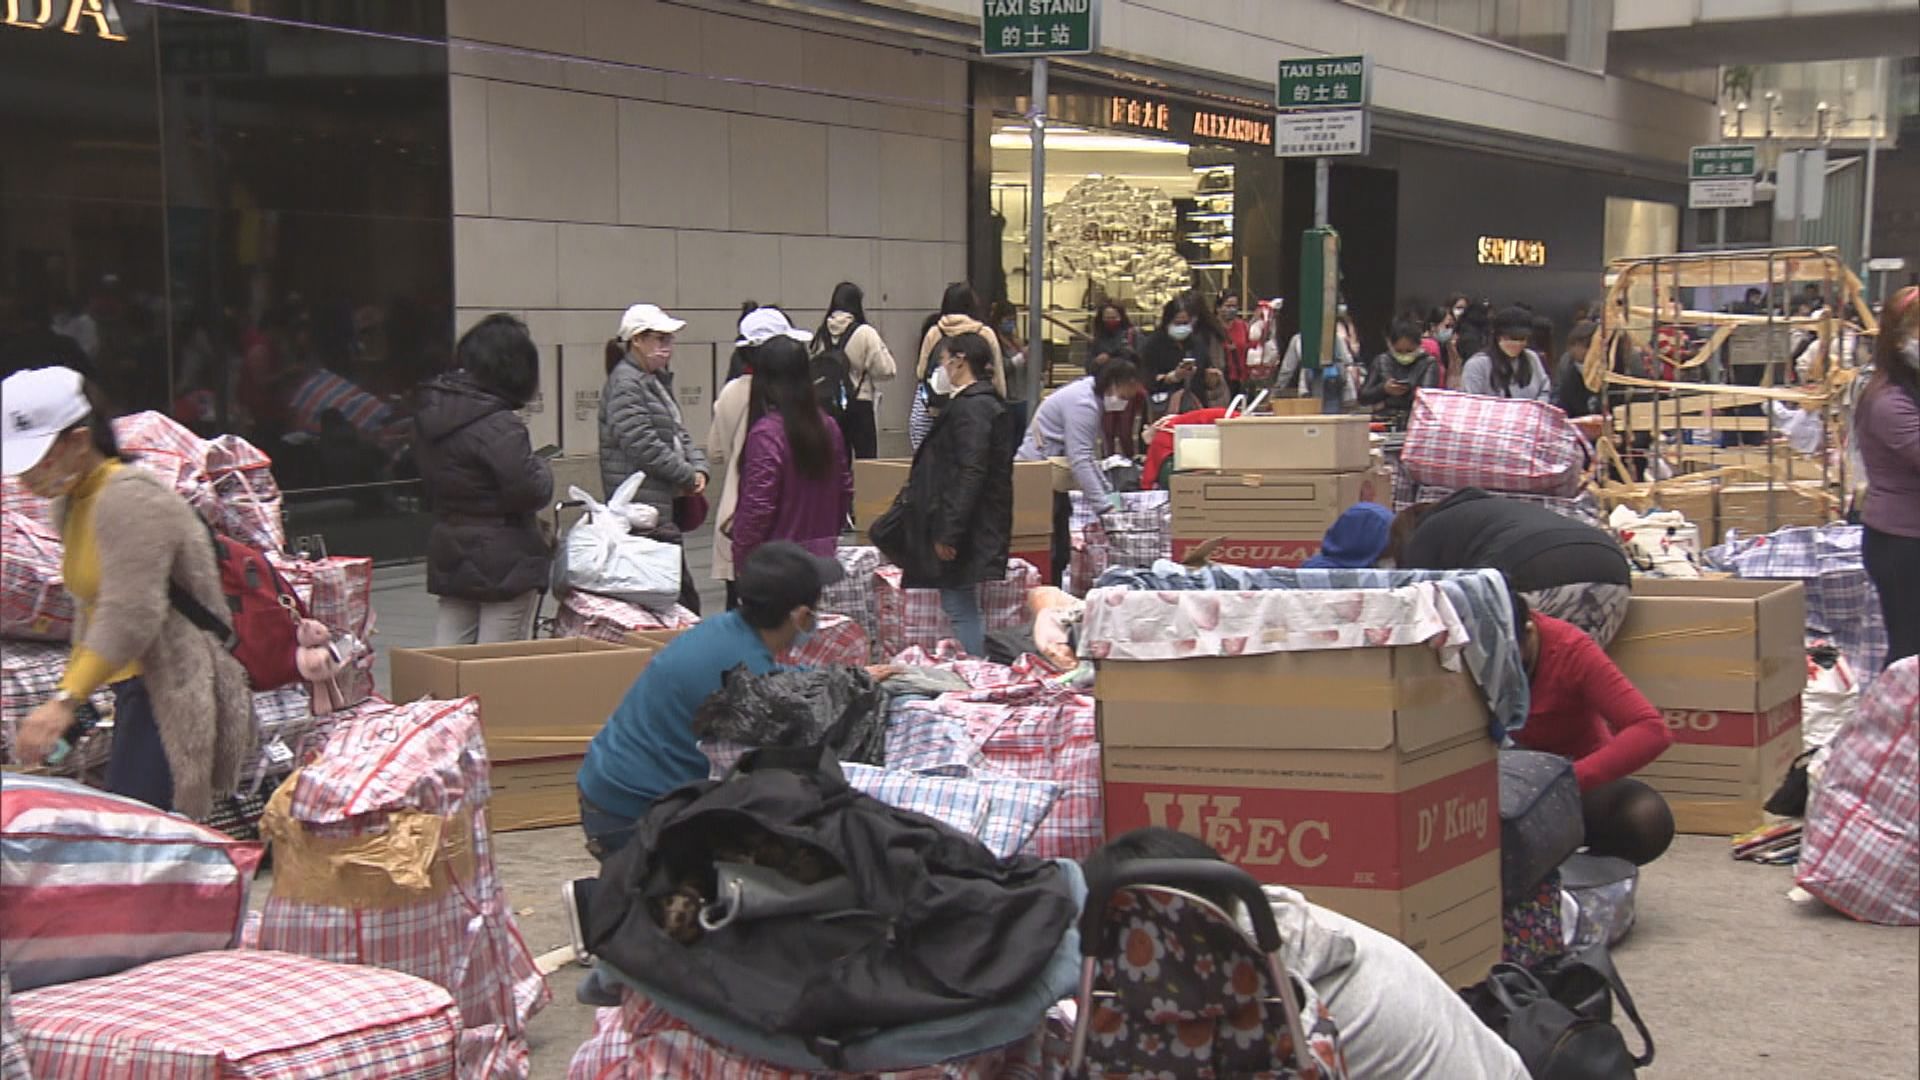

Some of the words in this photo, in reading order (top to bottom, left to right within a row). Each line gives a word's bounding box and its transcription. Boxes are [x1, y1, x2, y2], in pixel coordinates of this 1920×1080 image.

[986, 0, 1023, 16] TAXI
[1029, 0, 1087, 15] STAND
[1001, 24, 1070, 47] 的士站
[1281, 64, 1313, 78] TAXI
[1316, 62, 1361, 77] STAND
[1293, 82, 1349, 101] 的士站
[1184, 544, 1322, 562] EGULA
[1443, 797, 1488, 843] King
